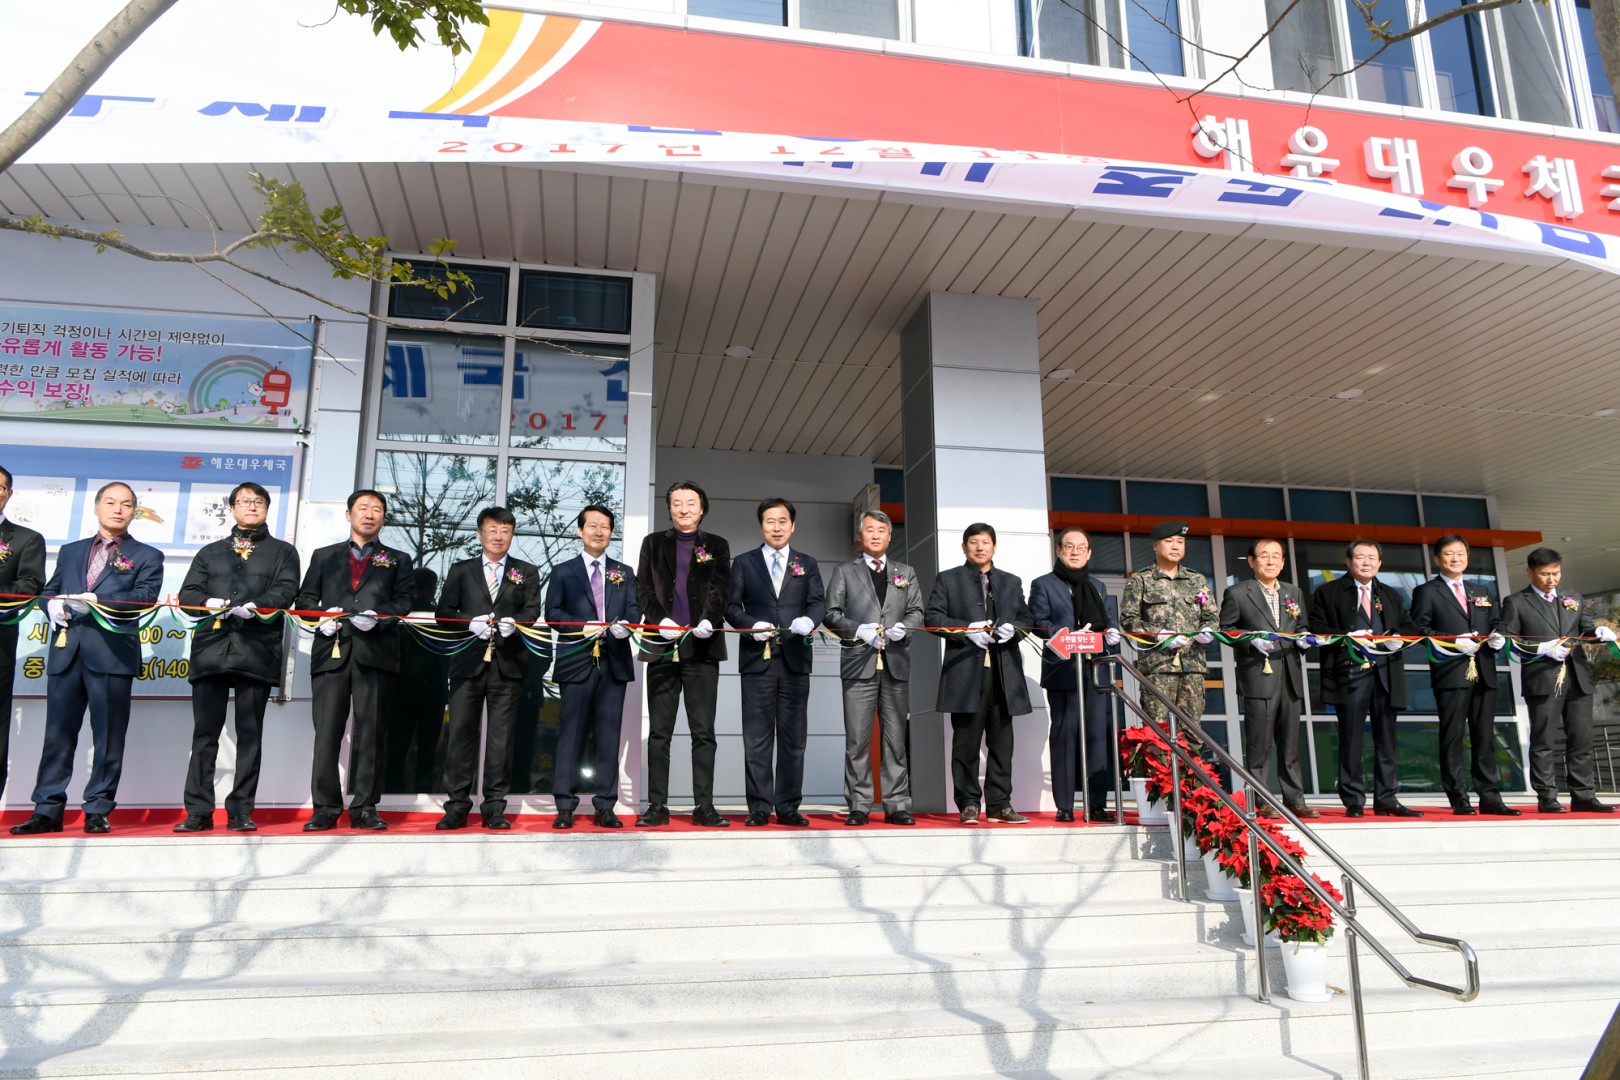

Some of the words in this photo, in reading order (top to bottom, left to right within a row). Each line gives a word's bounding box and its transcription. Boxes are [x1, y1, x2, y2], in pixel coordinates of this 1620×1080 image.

[53, 325, 111, 341] 걱정이나
[117, 328, 161, 343] 시간의
[167, 331, 225, 346] 제약없이
[0, 338, 62, 357] 유롭게
[69, 340, 109, 360] 활동
[117, 344, 162, 362] 가능!
[30, 365, 60, 378] 만큼
[65, 367, 96, 380] 모집
[102, 369, 147, 383] 실적에
[152, 372, 182, 385] 따라
[43, 381, 91, 401] 보장!
[211, 457, 287, 471] 해운대우체국
